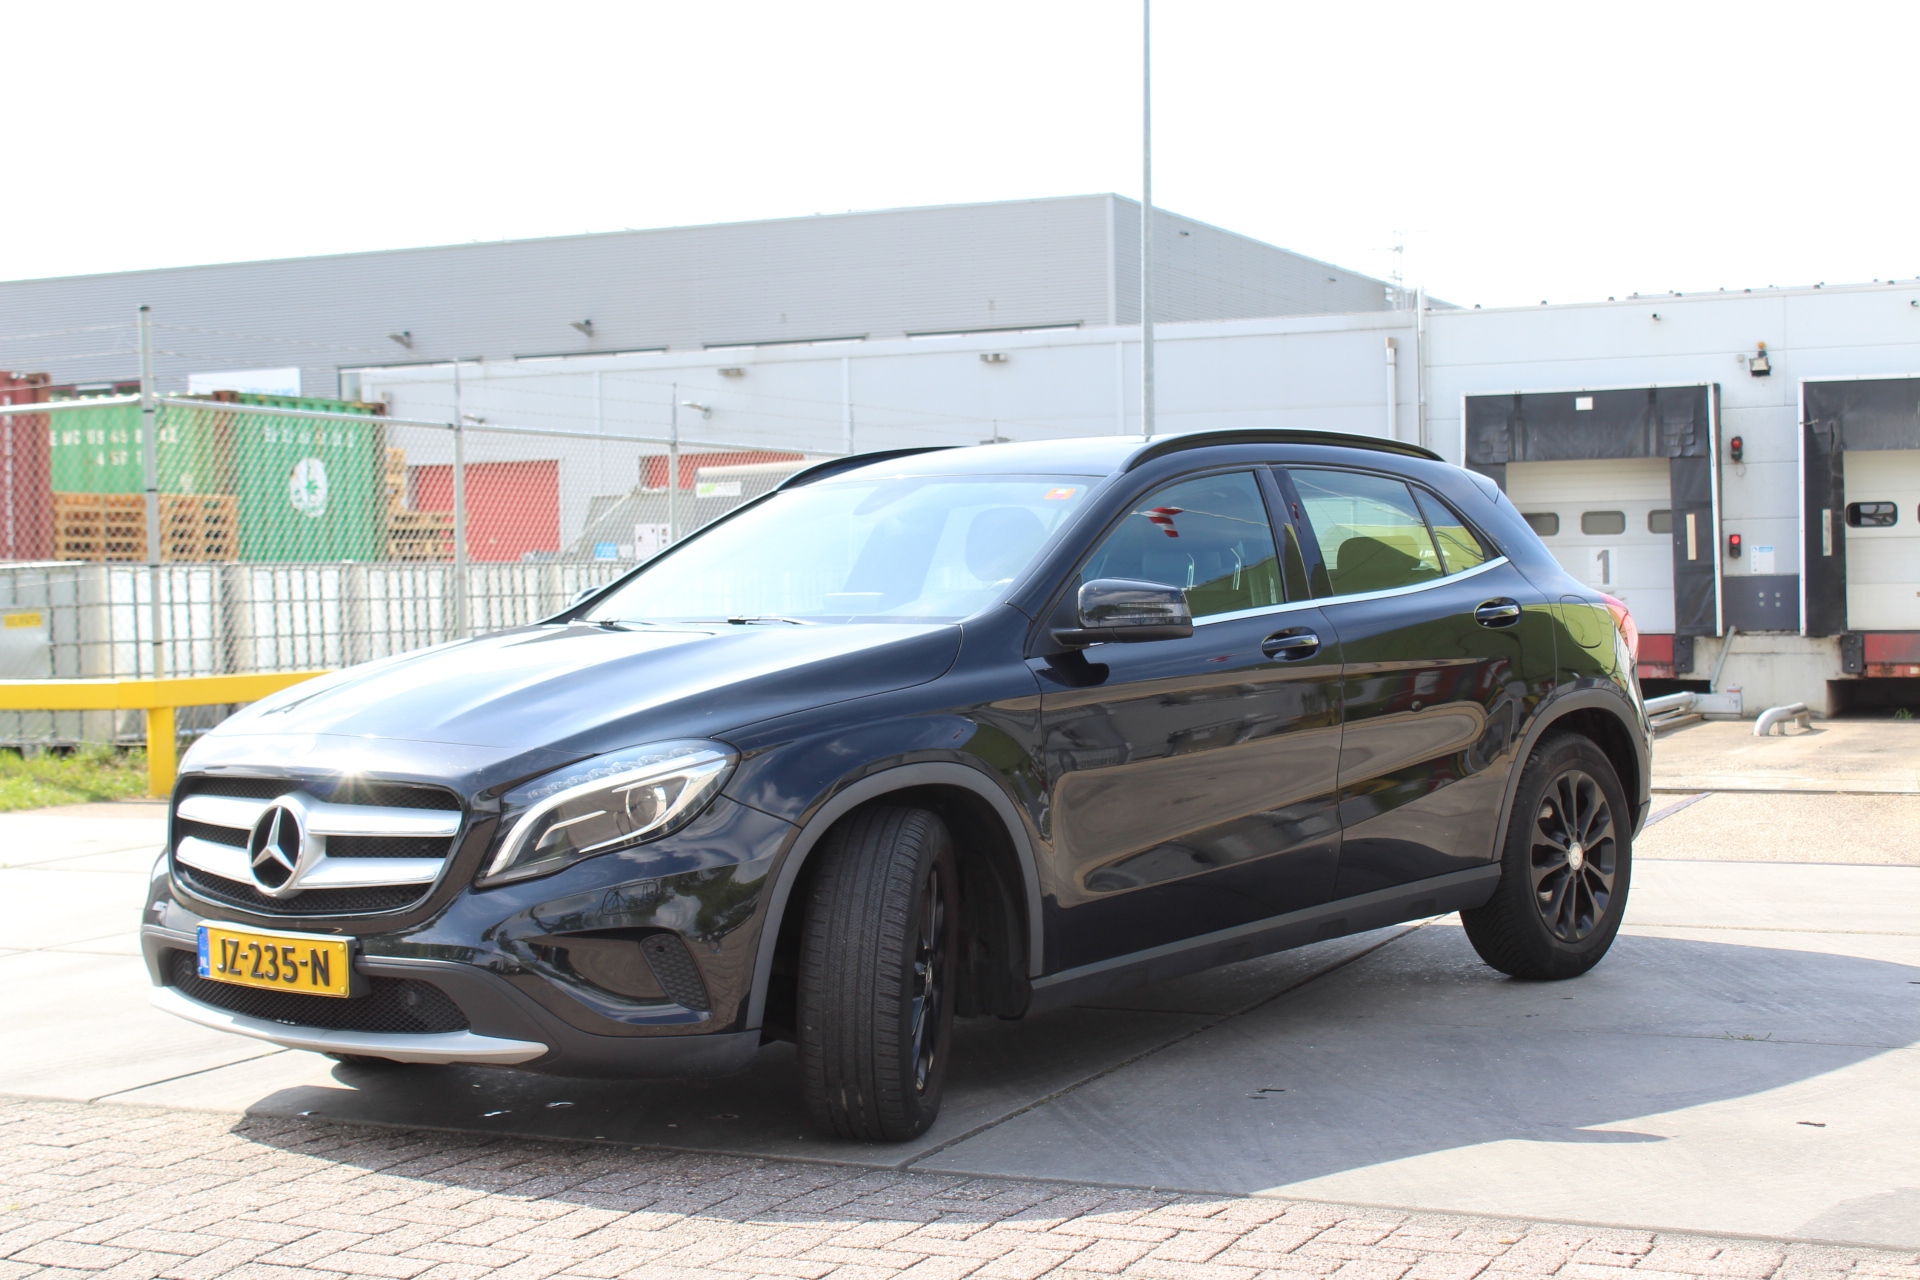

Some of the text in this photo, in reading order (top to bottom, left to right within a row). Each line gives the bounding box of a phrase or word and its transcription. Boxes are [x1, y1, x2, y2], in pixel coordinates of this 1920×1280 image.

[1597, 549, 1610, 585] 1
[200, 937, 330, 986] NL JZ-235-N
